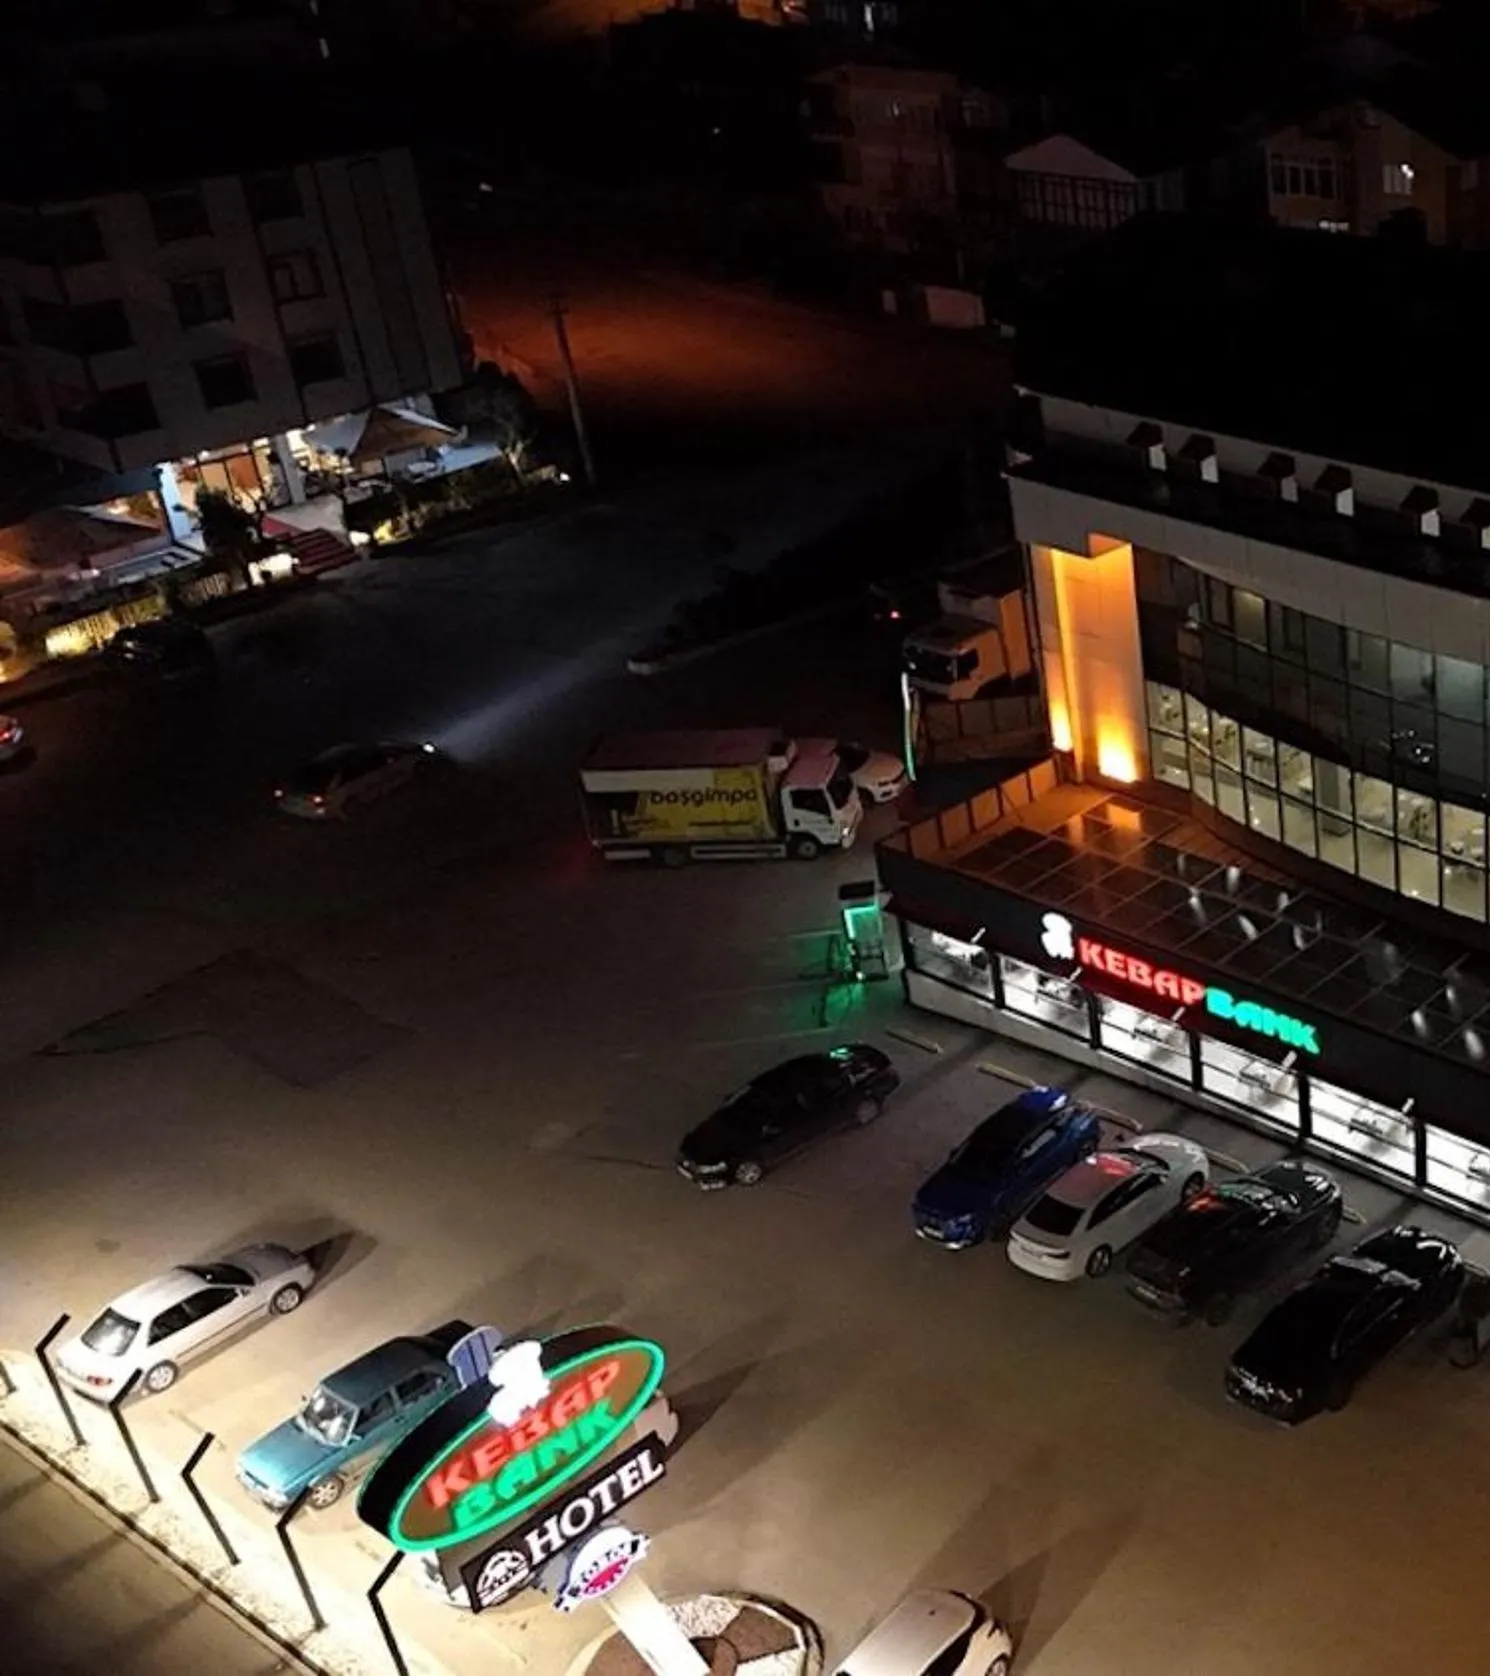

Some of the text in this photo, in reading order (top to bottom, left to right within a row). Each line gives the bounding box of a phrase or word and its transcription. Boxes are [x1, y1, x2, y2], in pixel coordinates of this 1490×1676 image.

[424, 1360, 621, 1510] KEBAP
[450, 1396, 618, 1530] BANK
[525, 1448, 664, 1564] HOTEL
